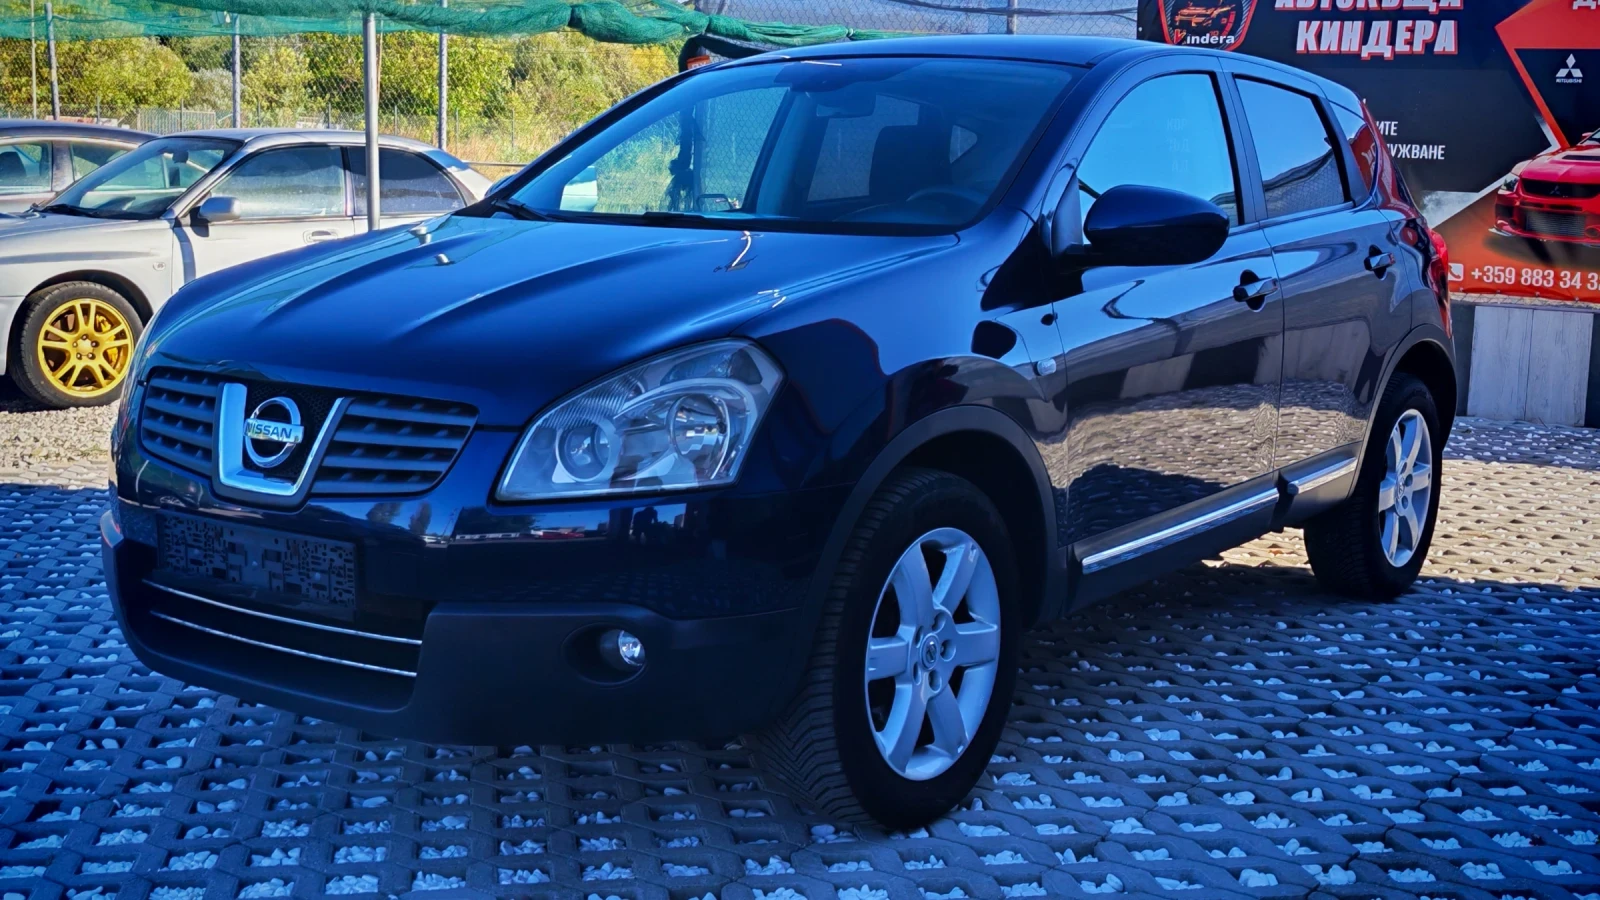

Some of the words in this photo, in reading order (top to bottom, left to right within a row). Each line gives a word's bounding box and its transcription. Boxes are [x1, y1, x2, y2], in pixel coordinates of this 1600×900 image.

[1296, 20, 1458, 60] КИНДЕРА
[1376, 121, 1398, 136] ИТЕ
[1387, 143, 1446, 160] УЖВАНЕ
[1471, 265, 1516, 285] +359
[1520, 268, 1555, 288] 883
[1560, 271, 1582, 290] 34
[1587, 273, 1600, 291] 3
[245, 421, 292, 439] NISSAN
